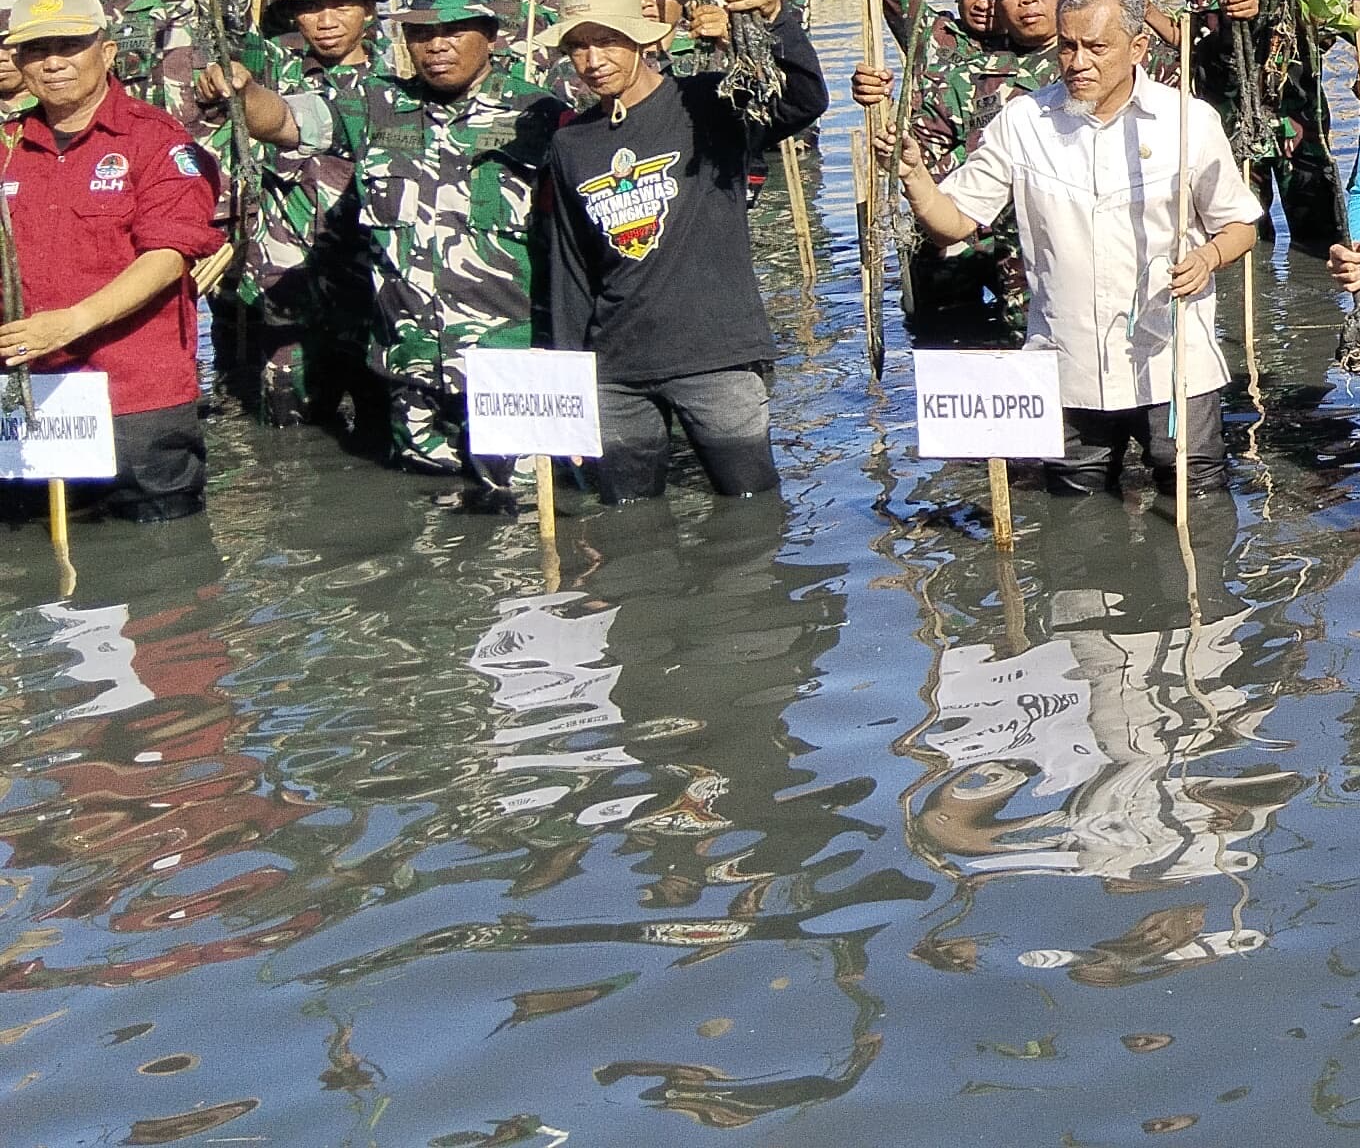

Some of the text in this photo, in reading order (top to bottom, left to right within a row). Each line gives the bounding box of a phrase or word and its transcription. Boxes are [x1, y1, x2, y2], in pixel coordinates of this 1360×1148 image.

[90, 179, 124, 192] DLH
[600, 199, 661, 232] PANGKEP
[474, 392, 585, 419] KETUA PENGADILAN NEGERI
[922, 393, 1045, 419] KETUA DPRD
[73, 415, 98, 440] HIDUP
